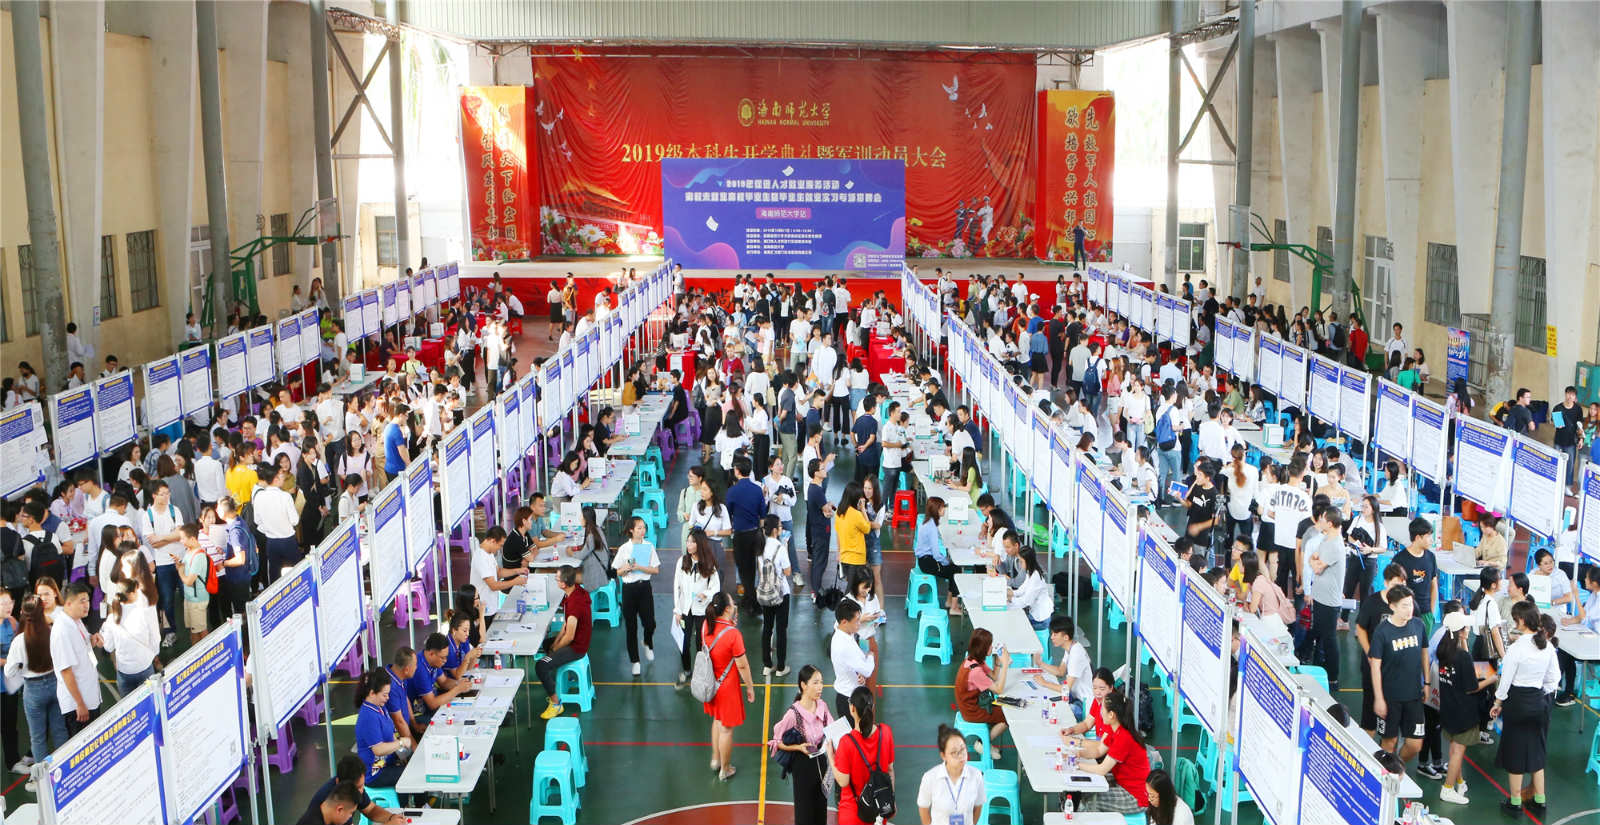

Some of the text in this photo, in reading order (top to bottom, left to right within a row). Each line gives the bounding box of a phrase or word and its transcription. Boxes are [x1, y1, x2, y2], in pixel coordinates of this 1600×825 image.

[758, 98, 831, 119] 海南师范大学
